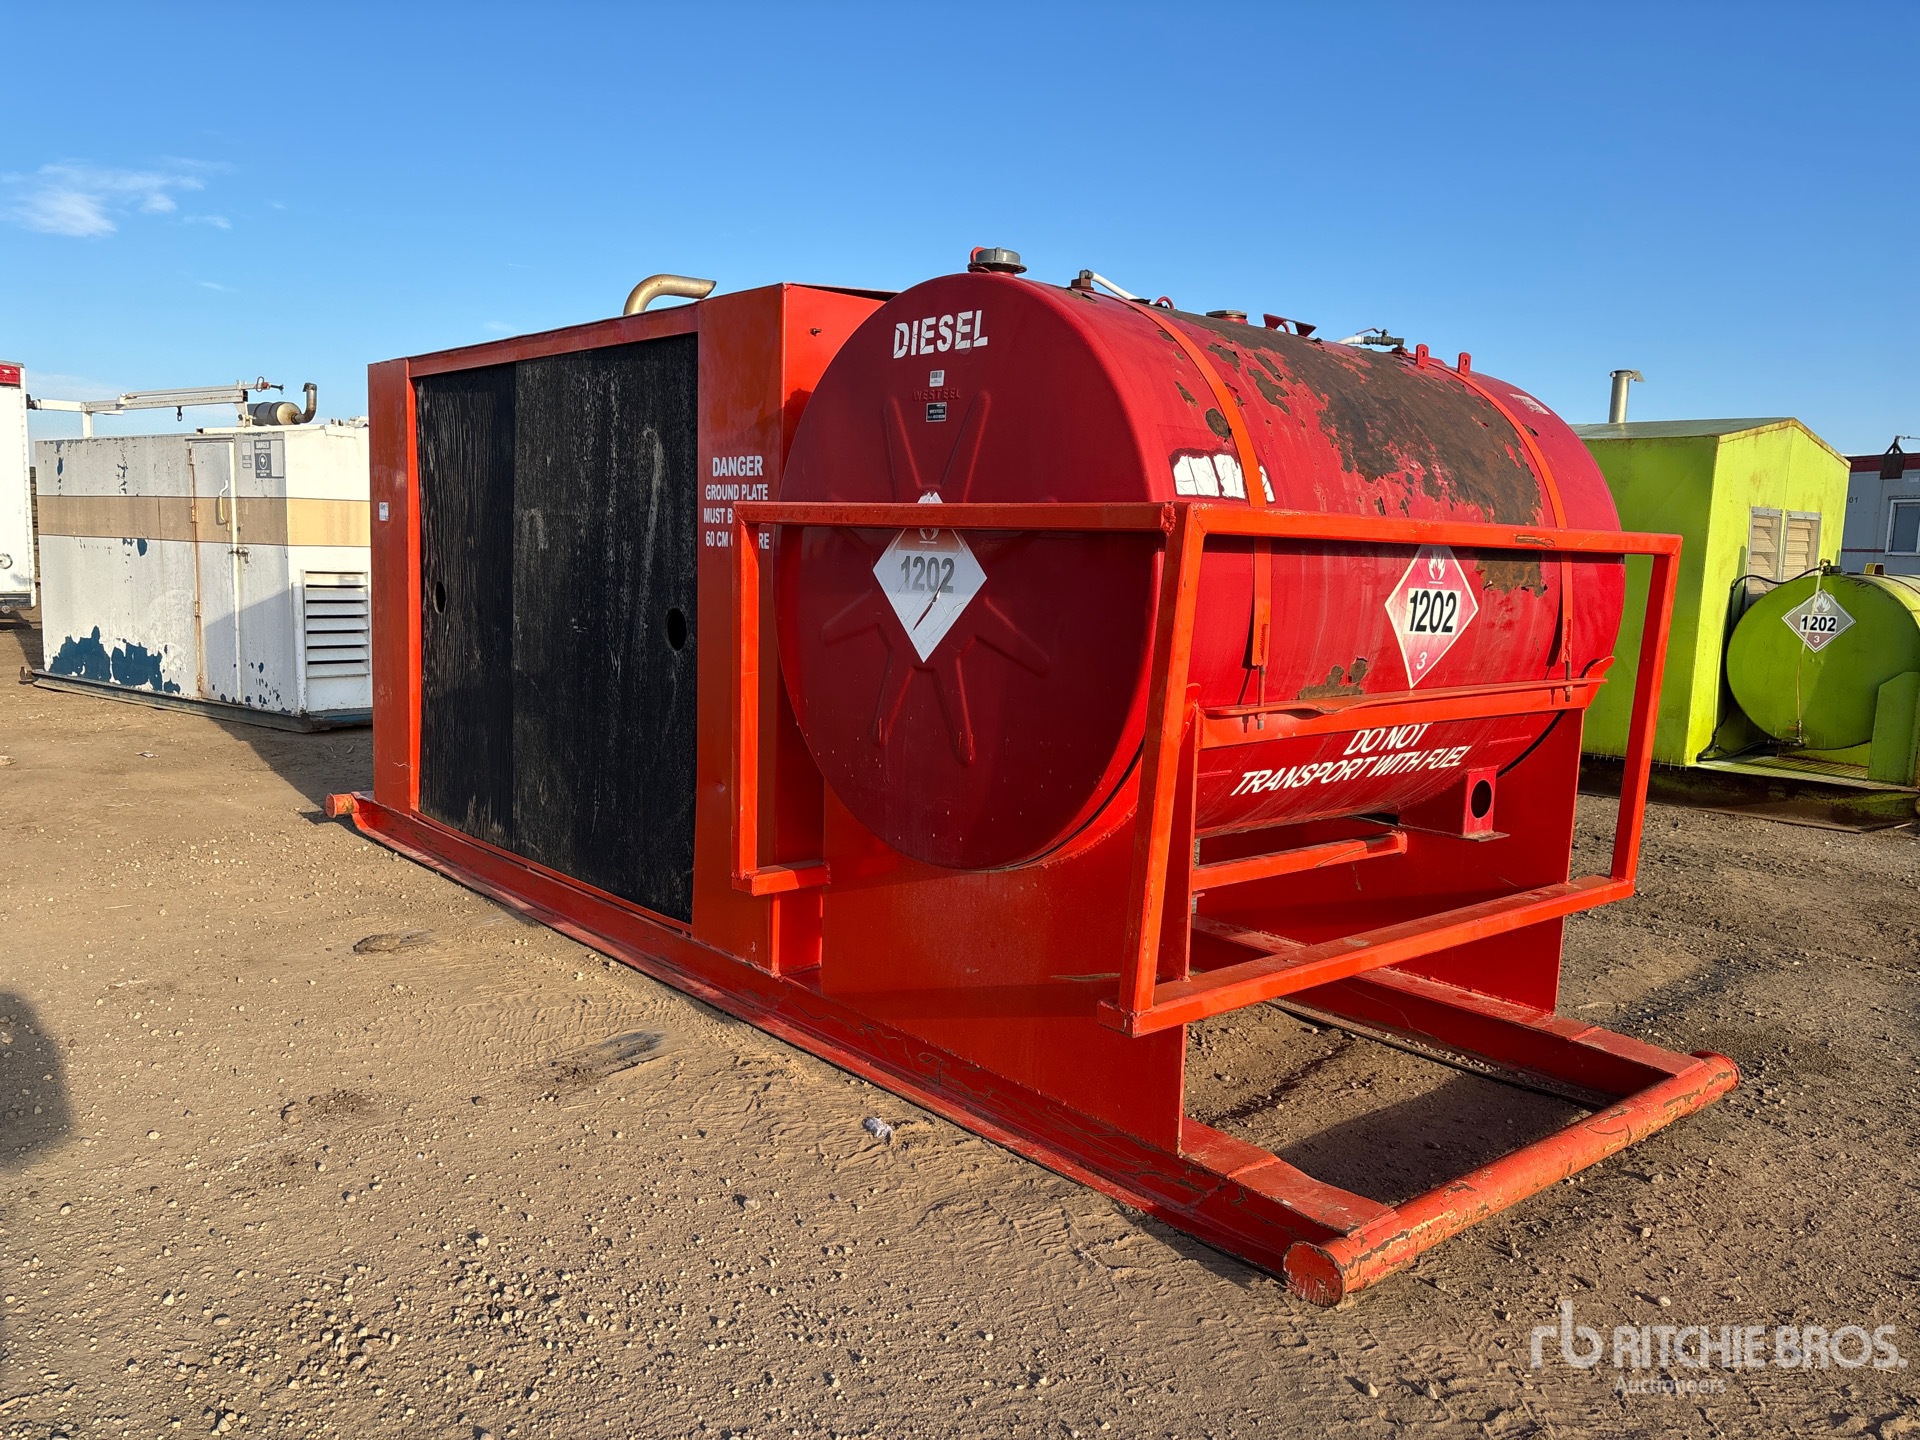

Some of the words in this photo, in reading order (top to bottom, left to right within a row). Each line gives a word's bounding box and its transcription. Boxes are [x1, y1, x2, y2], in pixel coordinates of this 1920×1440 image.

[893, 310, 988, 359] DIESEL
[912, 388, 960, 401] WESTEEL
[712, 455, 763, 477] DANGER
[705, 484, 739, 500] GROUND
[741, 484, 769, 500] PLATE
[703, 508, 726, 523] MUST
[705, 531, 715, 547] 60
[716, 531, 729, 547] CM
[900, 555, 955, 593] 1202
[1409, 590, 1457, 633] 1202
[1801, 615, 1837, 632] 1202
[1813, 635, 1820, 643] 3
[1416, 651, 1428, 670] 3
[1343, 728, 1385, 756] DO
[1381, 722, 1433, 750] NOT
[1229, 756, 1377, 796] TRANSPORT
[1366, 750, 1426, 778] WITH
[1421, 745, 1472, 770] FUEL
